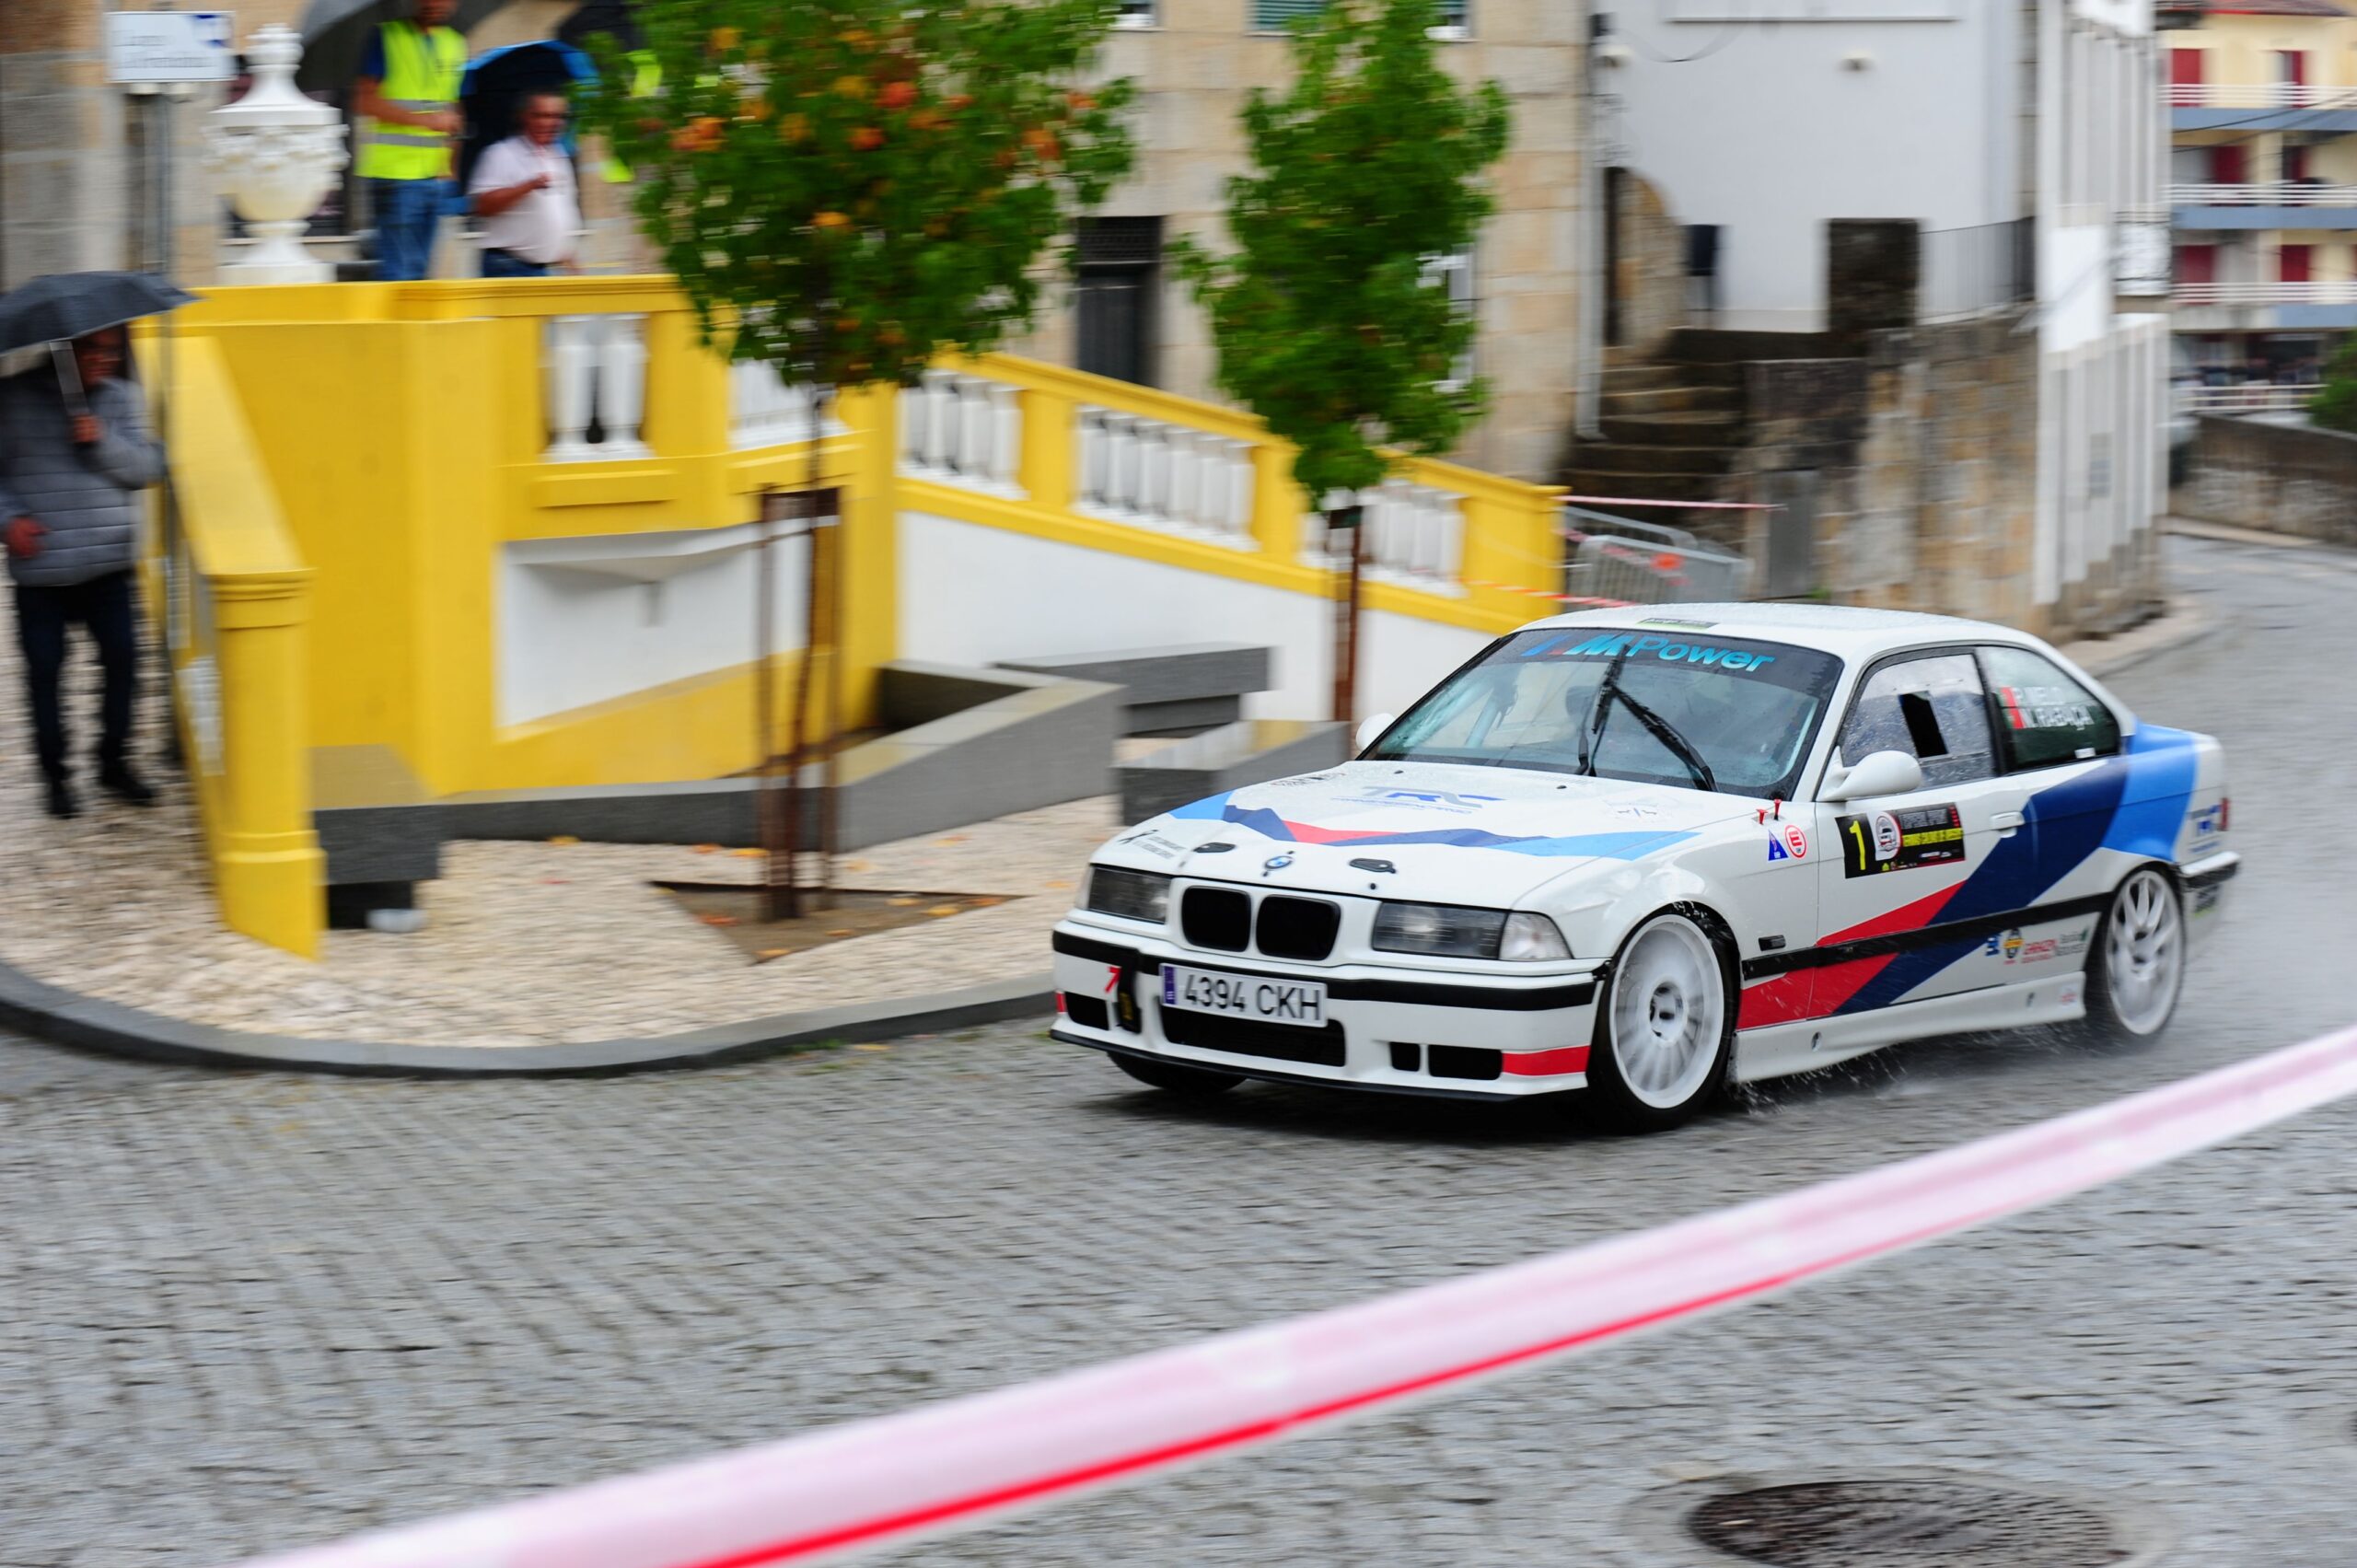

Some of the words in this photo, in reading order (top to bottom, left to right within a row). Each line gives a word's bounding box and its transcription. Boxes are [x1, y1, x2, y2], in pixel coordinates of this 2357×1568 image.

[1849, 819, 1866, 871] 1
[1185, 974, 1246, 1012] 4394
[1257, 985, 1320, 1020] CKH
